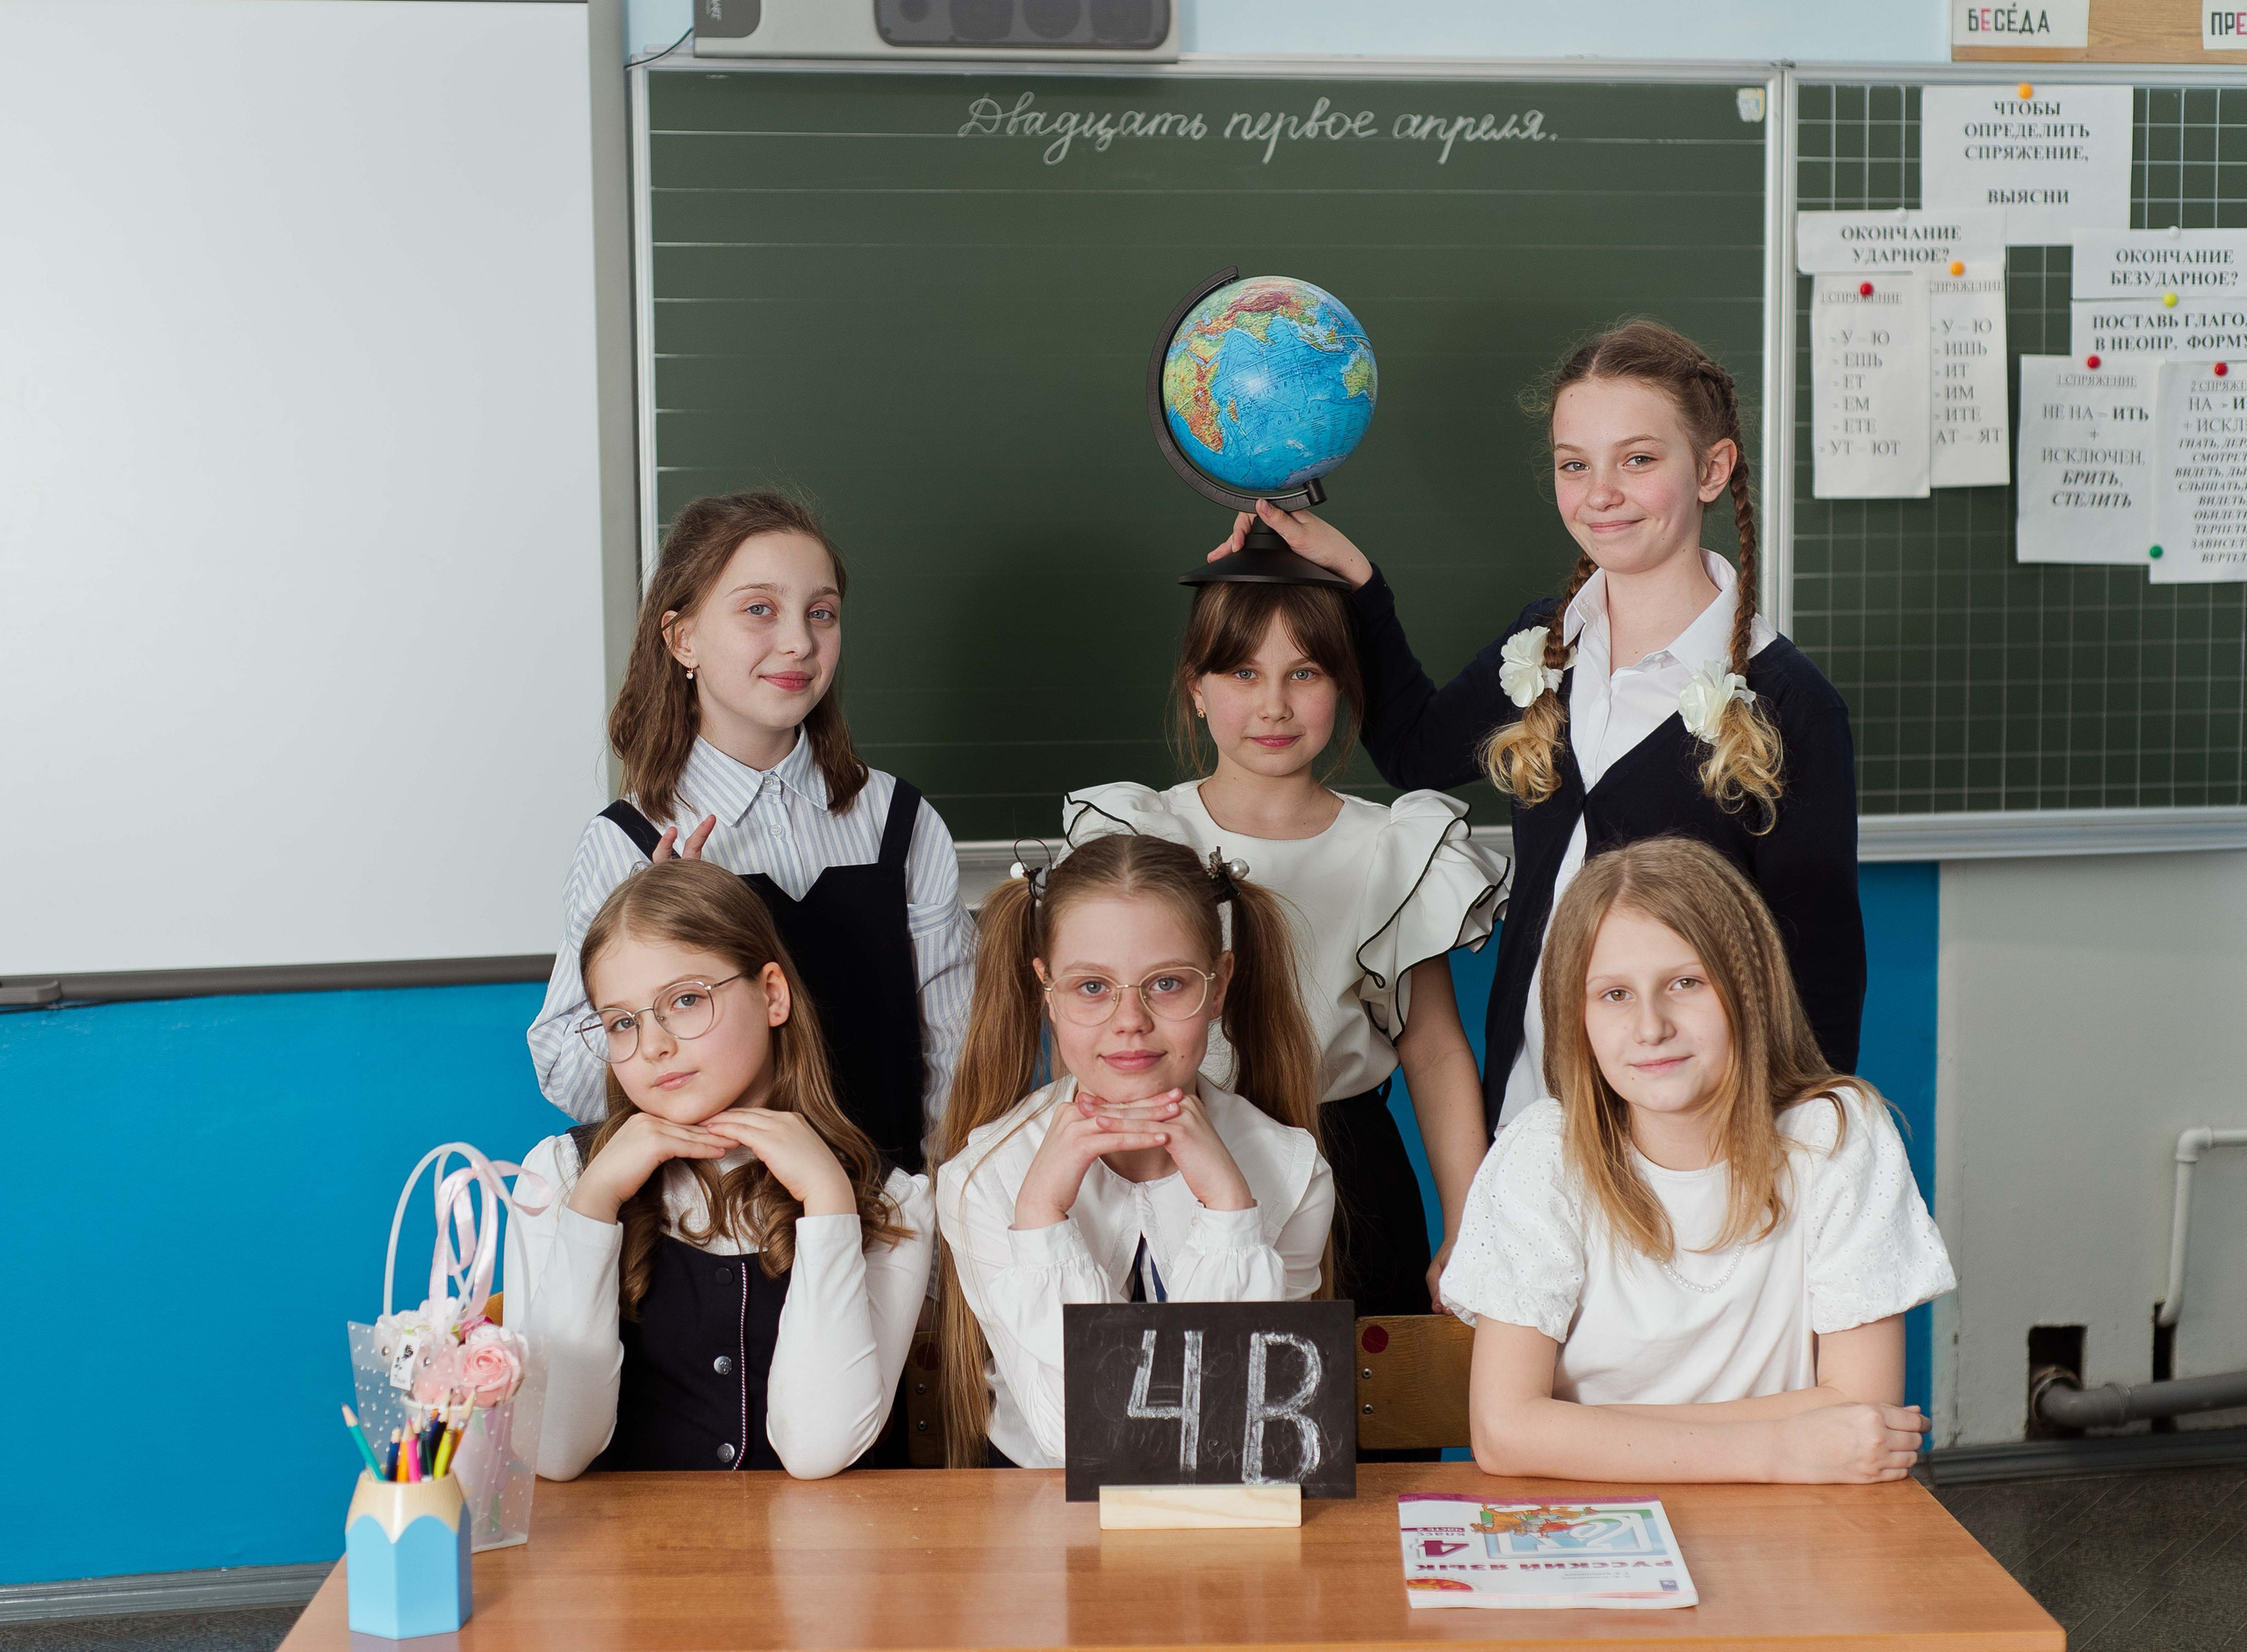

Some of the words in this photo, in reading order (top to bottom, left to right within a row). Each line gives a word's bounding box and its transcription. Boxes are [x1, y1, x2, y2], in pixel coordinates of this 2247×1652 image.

[1993, 101, 2061, 116] ЧТОБЫ
[957, 91, 1208, 165] Двадцать
[1224, 97, 1378, 164] первое
[1392, 110, 1558, 165] апреля.
[1963, 122, 2090, 140] ОПРЕДЕЛИТЬ
[1964, 145, 2089, 162] СПРЯЖЕНИЕ,
[1988, 189, 2069, 205] ВЫЯСНИ
[1841, 226, 1962, 241] ОКОНЧАНИЕ
[1852, 247, 1949, 265] УДАРНОЕ?
[2116, 248, 2235, 264] ОКОНЧАНИЕ
[2111, 270, 2238, 289] БЕЗУДАРНОЕ?
[1974, 318, 1992, 334] Ю
[2093, 314, 2179, 331] ПОСТАВЬ
[2185, 312, 2247, 328] ГЛАГО
[1871, 330, 1890, 347] Ю
[2095, 335, 2106, 351] В
[2064, 373, 2137, 387] СПРЯЖЕНИЕ
[2042, 403, 2064, 420] НЕ
[2070, 405, 2093, 421] НА
[2189, 396, 2212, 412] НА
[2063, 470, 2123, 487] БРИТЬ,
[2052, 490, 2132, 508] СТЕЛИТЬ
[1418, 1540, 1470, 1558] 4
[1520, 1560, 1674, 1571] РУССКИЙ
